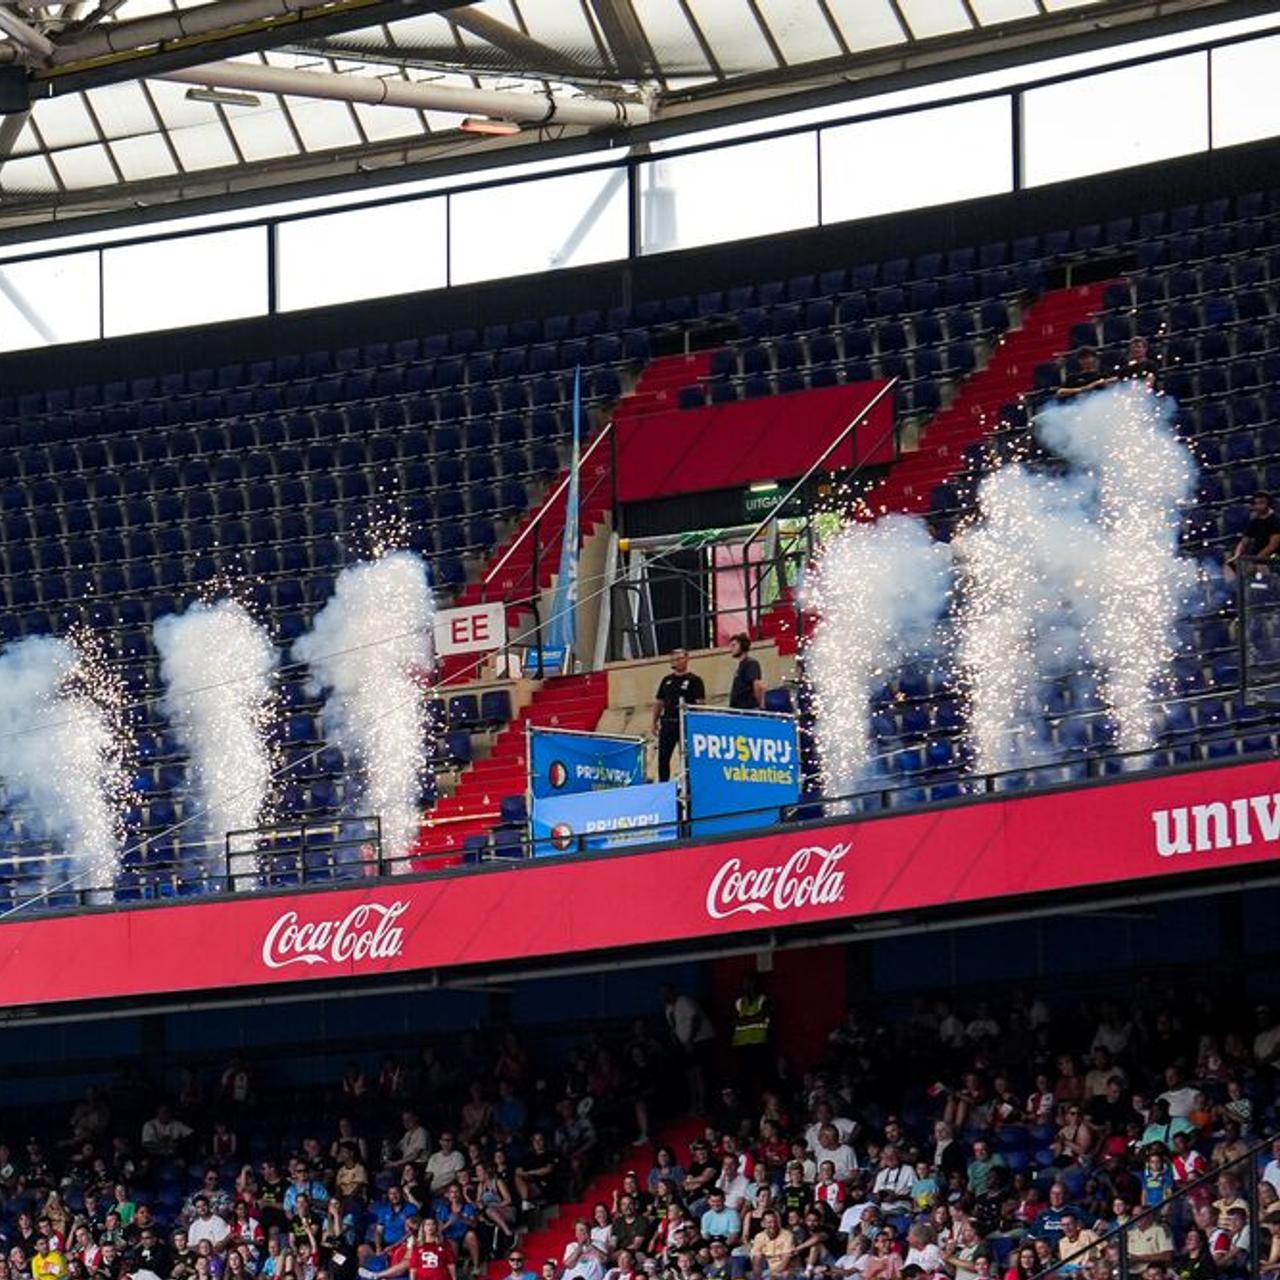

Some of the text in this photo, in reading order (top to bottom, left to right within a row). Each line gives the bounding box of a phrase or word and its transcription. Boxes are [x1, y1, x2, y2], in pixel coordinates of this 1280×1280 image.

[451, 614, 490, 644] EE
[723, 764, 793, 785] vakanties
[706, 842, 854, 919] Coca-Cola
[262, 900, 413, 968] Coca-Cola
